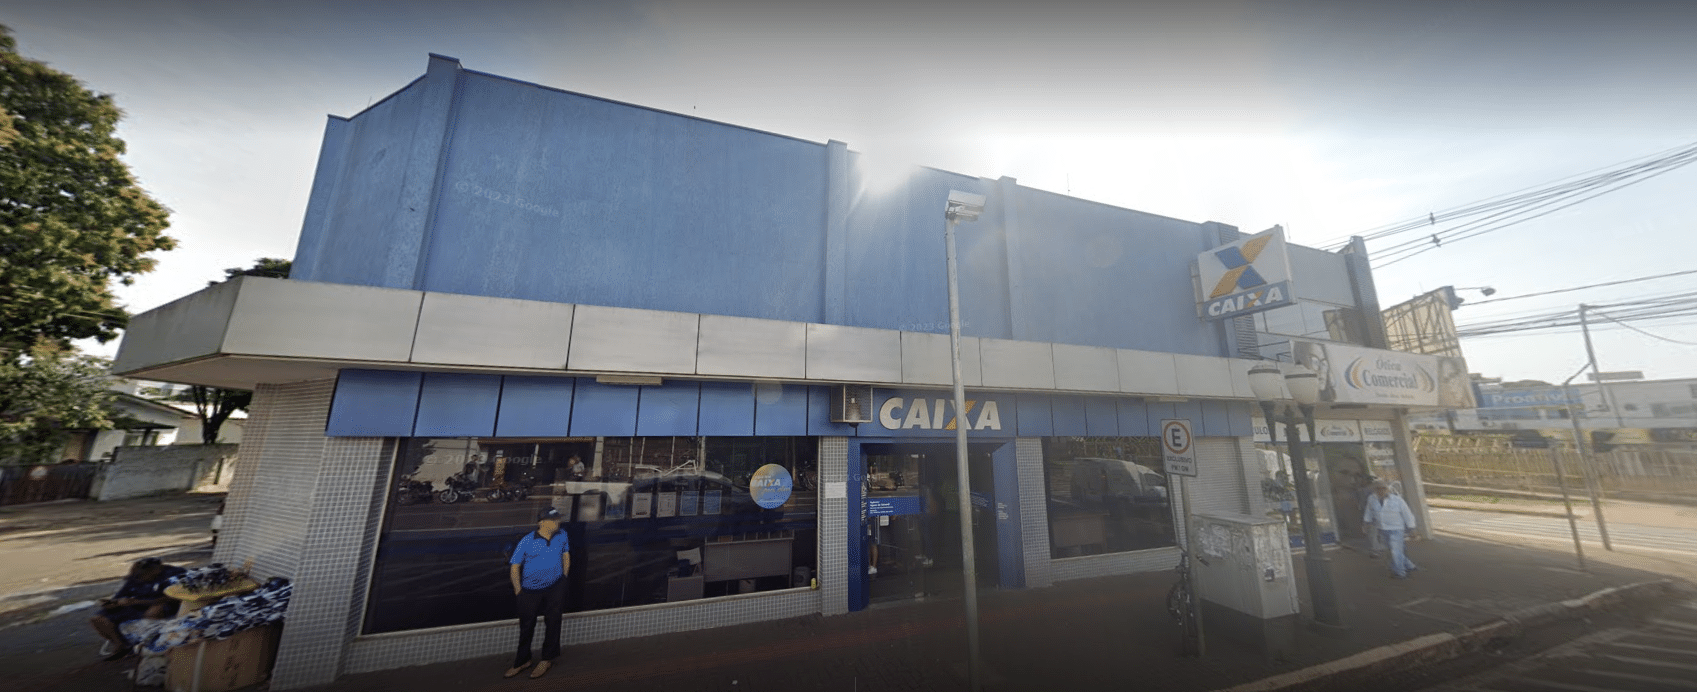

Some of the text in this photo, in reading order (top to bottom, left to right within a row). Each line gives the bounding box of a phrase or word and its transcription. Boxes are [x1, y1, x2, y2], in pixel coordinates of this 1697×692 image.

[1207, 286, 1284, 317] CAIXA
[1362, 369, 1419, 390] Comercial
[879, 397, 1002, 430] CAIXA
[1171, 428, 1182, 447] E
[1254, 426, 1270, 436] ULO
